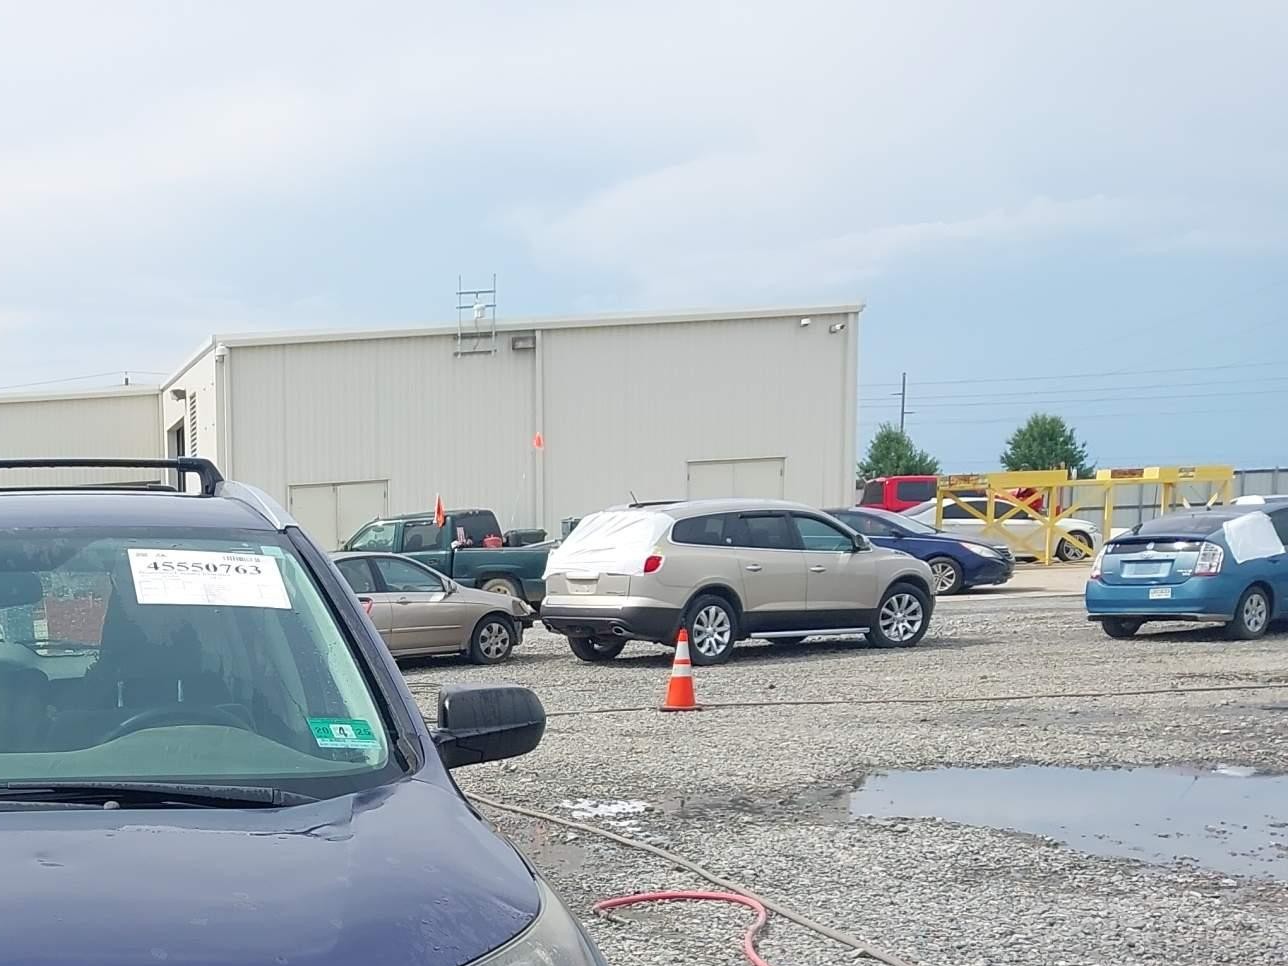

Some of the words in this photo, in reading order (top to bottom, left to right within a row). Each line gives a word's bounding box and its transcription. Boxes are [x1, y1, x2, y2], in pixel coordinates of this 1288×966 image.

[147, 561, 262, 576] 45550763
[314, 726, 330, 735] 20
[338, 726, 348, 738] 4
